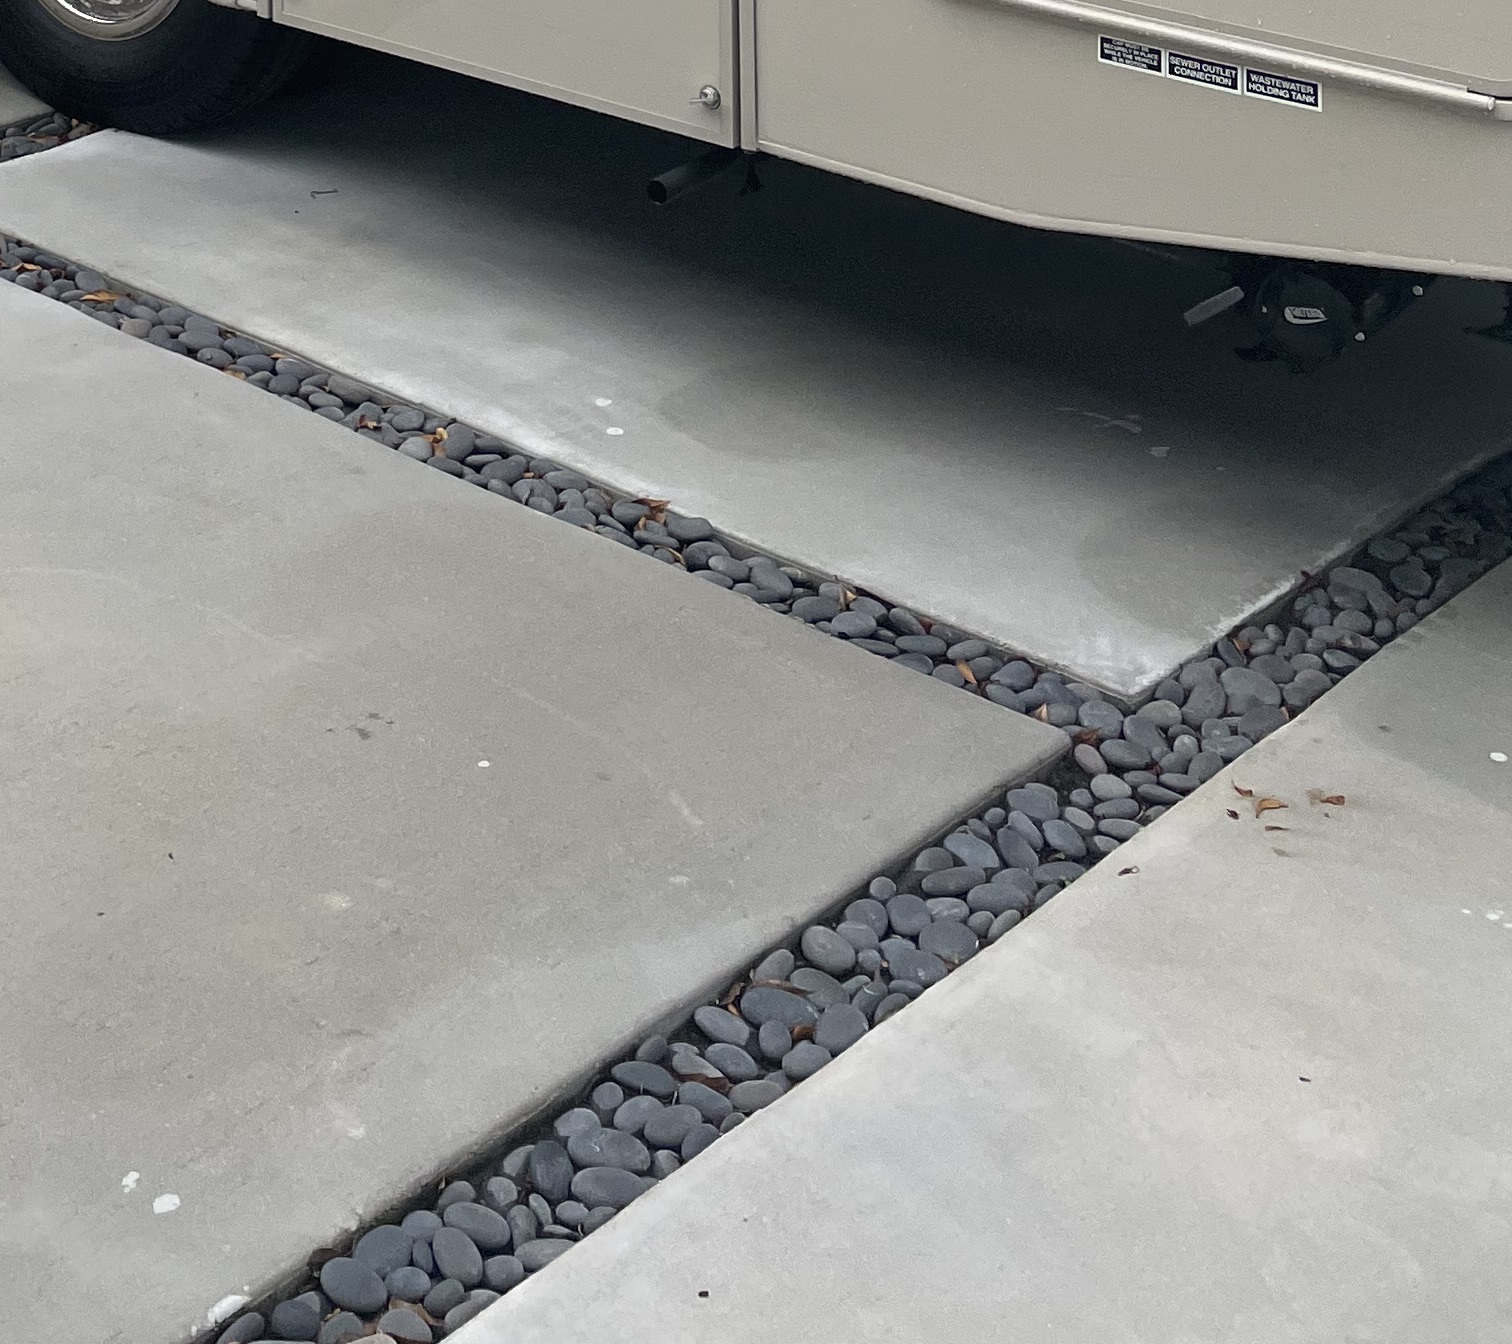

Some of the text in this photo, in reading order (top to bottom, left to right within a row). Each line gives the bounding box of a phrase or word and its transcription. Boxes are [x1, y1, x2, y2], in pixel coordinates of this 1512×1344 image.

[1169, 56, 1237, 78] SEWER OUTLET
[1174, 66, 1232, 86] CONNECTION
[1248, 82, 1290, 98] HOLDING
[1249, 73, 1314, 94] WASTEWATER
